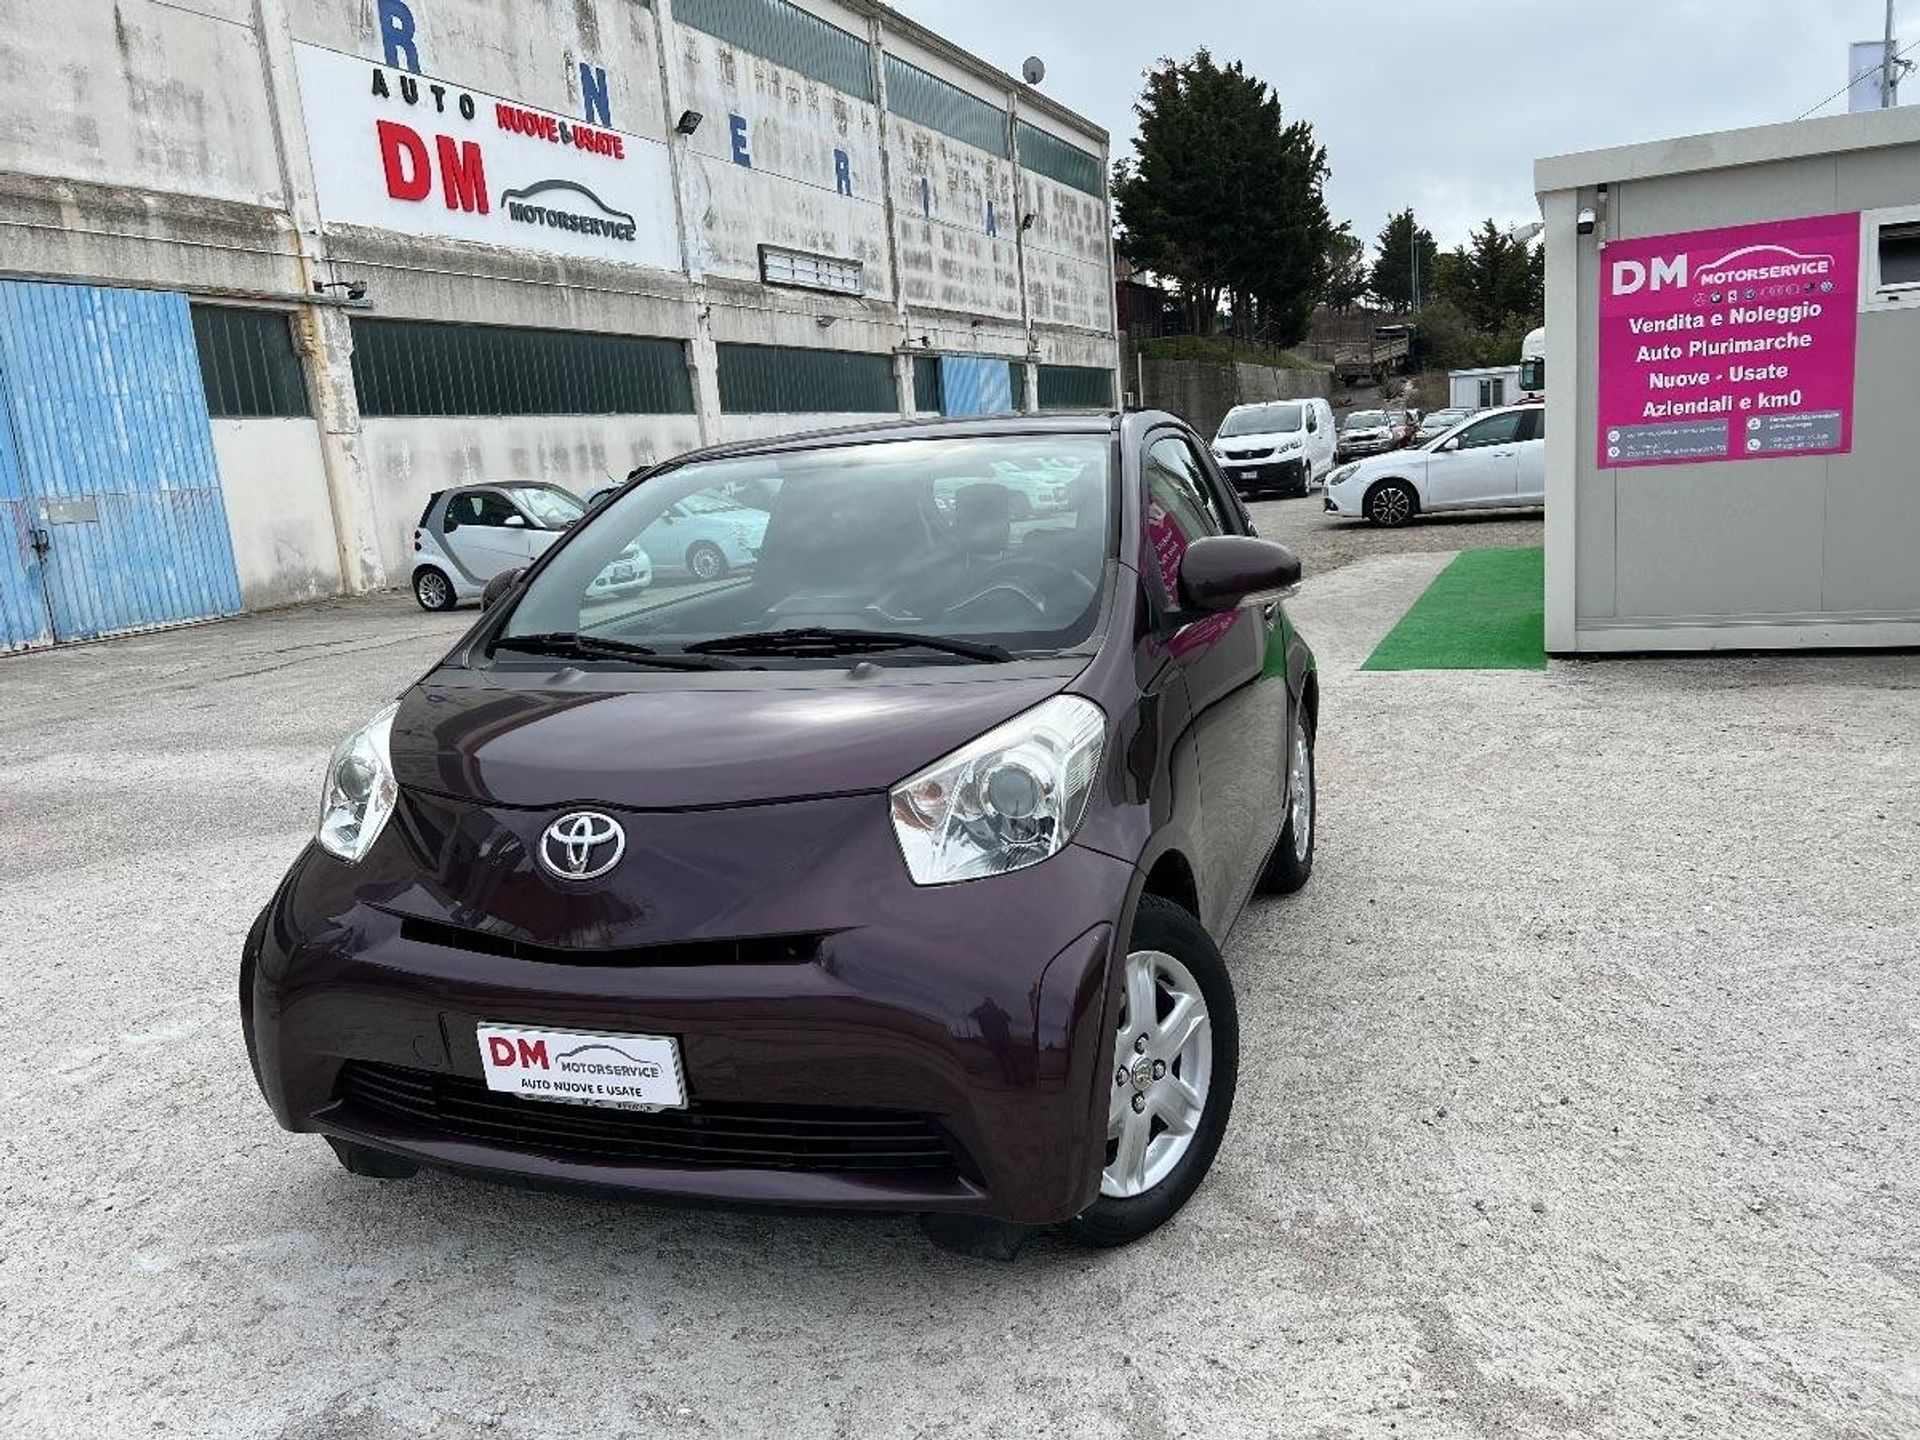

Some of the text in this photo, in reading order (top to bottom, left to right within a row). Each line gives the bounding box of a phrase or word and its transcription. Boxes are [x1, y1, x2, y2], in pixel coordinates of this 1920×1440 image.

[372, 69, 476, 120] AUTO
[376, 120, 490, 215] DM
[508, 202, 636, 241] MOTORSERVICE
[1612, 253, 1829, 296] DM MOTORSERVICE
[1629, 301, 1822, 334] Vendita e Noleggio
[1636, 331, 1812, 363] Auto Plurimarche
[1649, 371, 1710, 389] Nuove
[1729, 363, 1789, 382] Usate
[1643, 390, 1802, 417] Aziendali e km0
[488, 1037, 660, 1078] DM MOTORSERVICE
[521, 1078, 643, 1097] AUTO NUOVE E USATE
